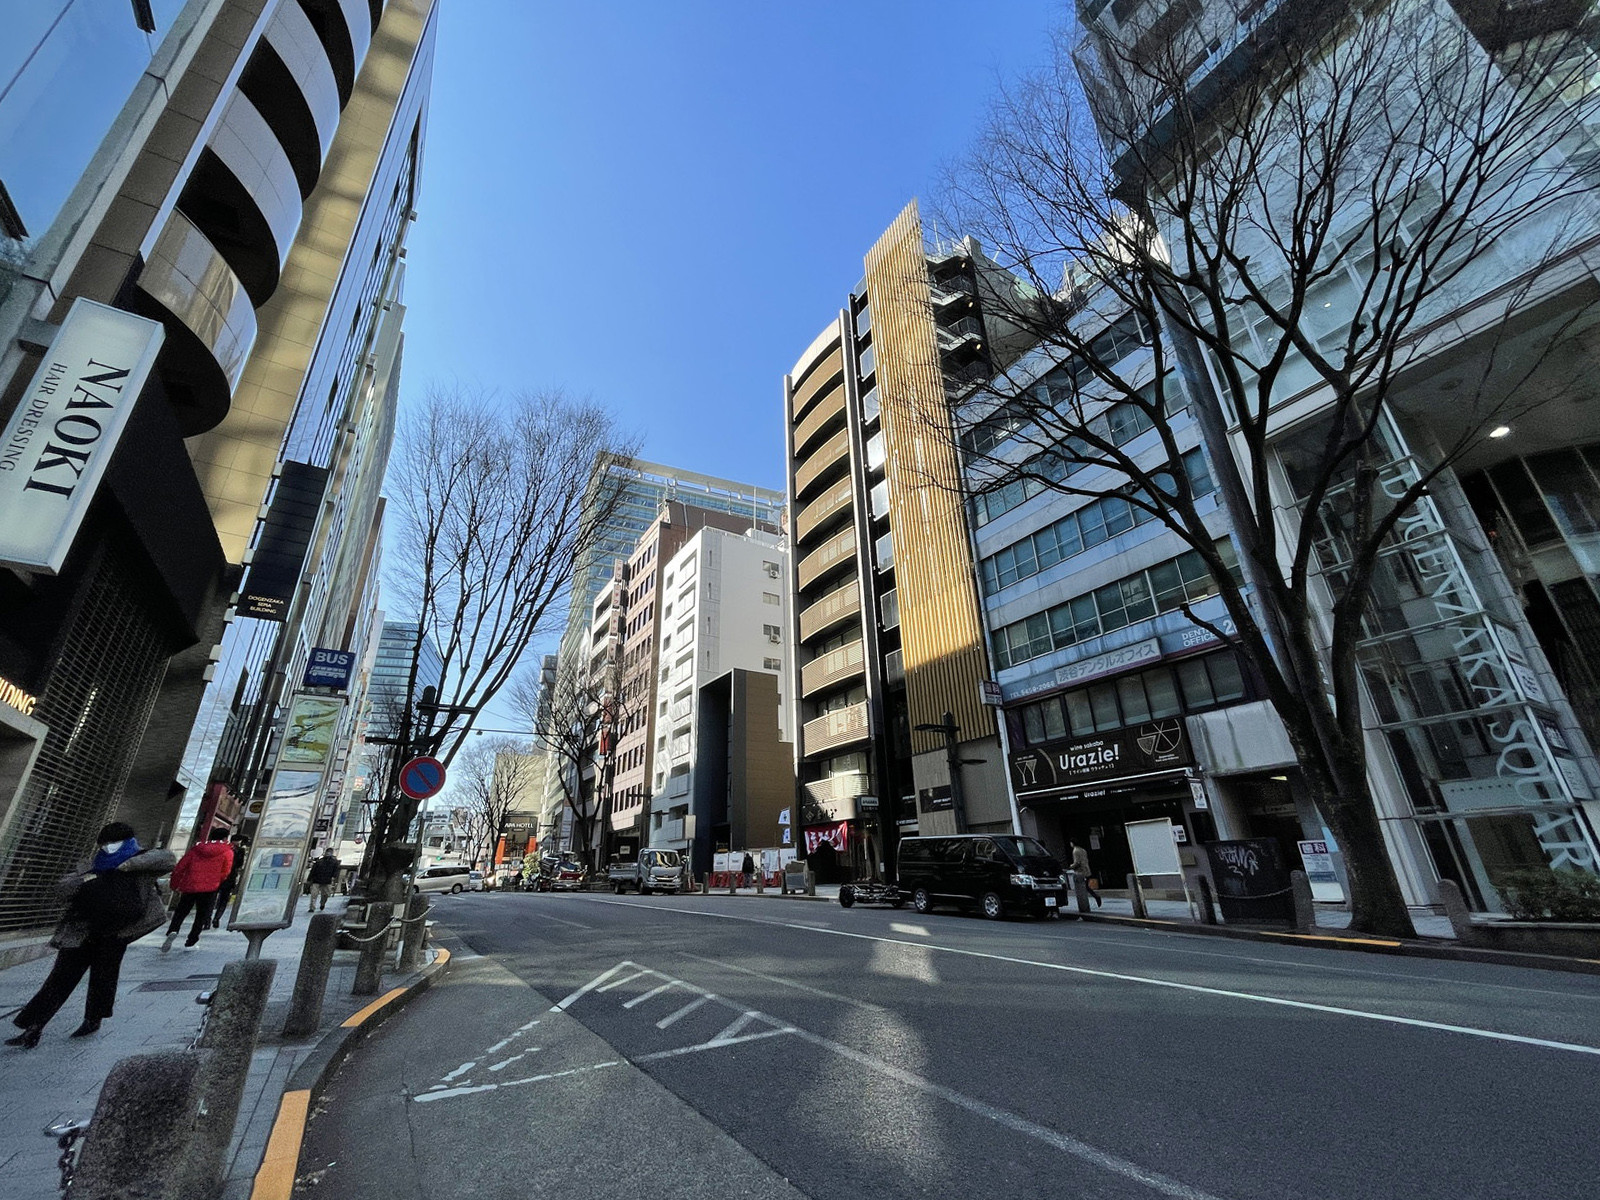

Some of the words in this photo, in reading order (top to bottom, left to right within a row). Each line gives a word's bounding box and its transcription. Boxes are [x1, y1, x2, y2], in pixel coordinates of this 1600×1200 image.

[38, 362, 68, 395] HAIR
[0, 398, 49, 471] DRESSING
[23, 358, 131, 500] NAOKI
[247, 595, 285, 605] DOGENZAKA
[250, 606, 277, 614] BUILDING
[1181, 627, 1209, 640] DENT
[314, 651, 349, 666] BUS
[1059, 643, 1156, 682] 渋谷デンタルオフィス
[1059, 743, 1120, 770] Urazie!
[1486, 718, 1596, 873] SQUAR
